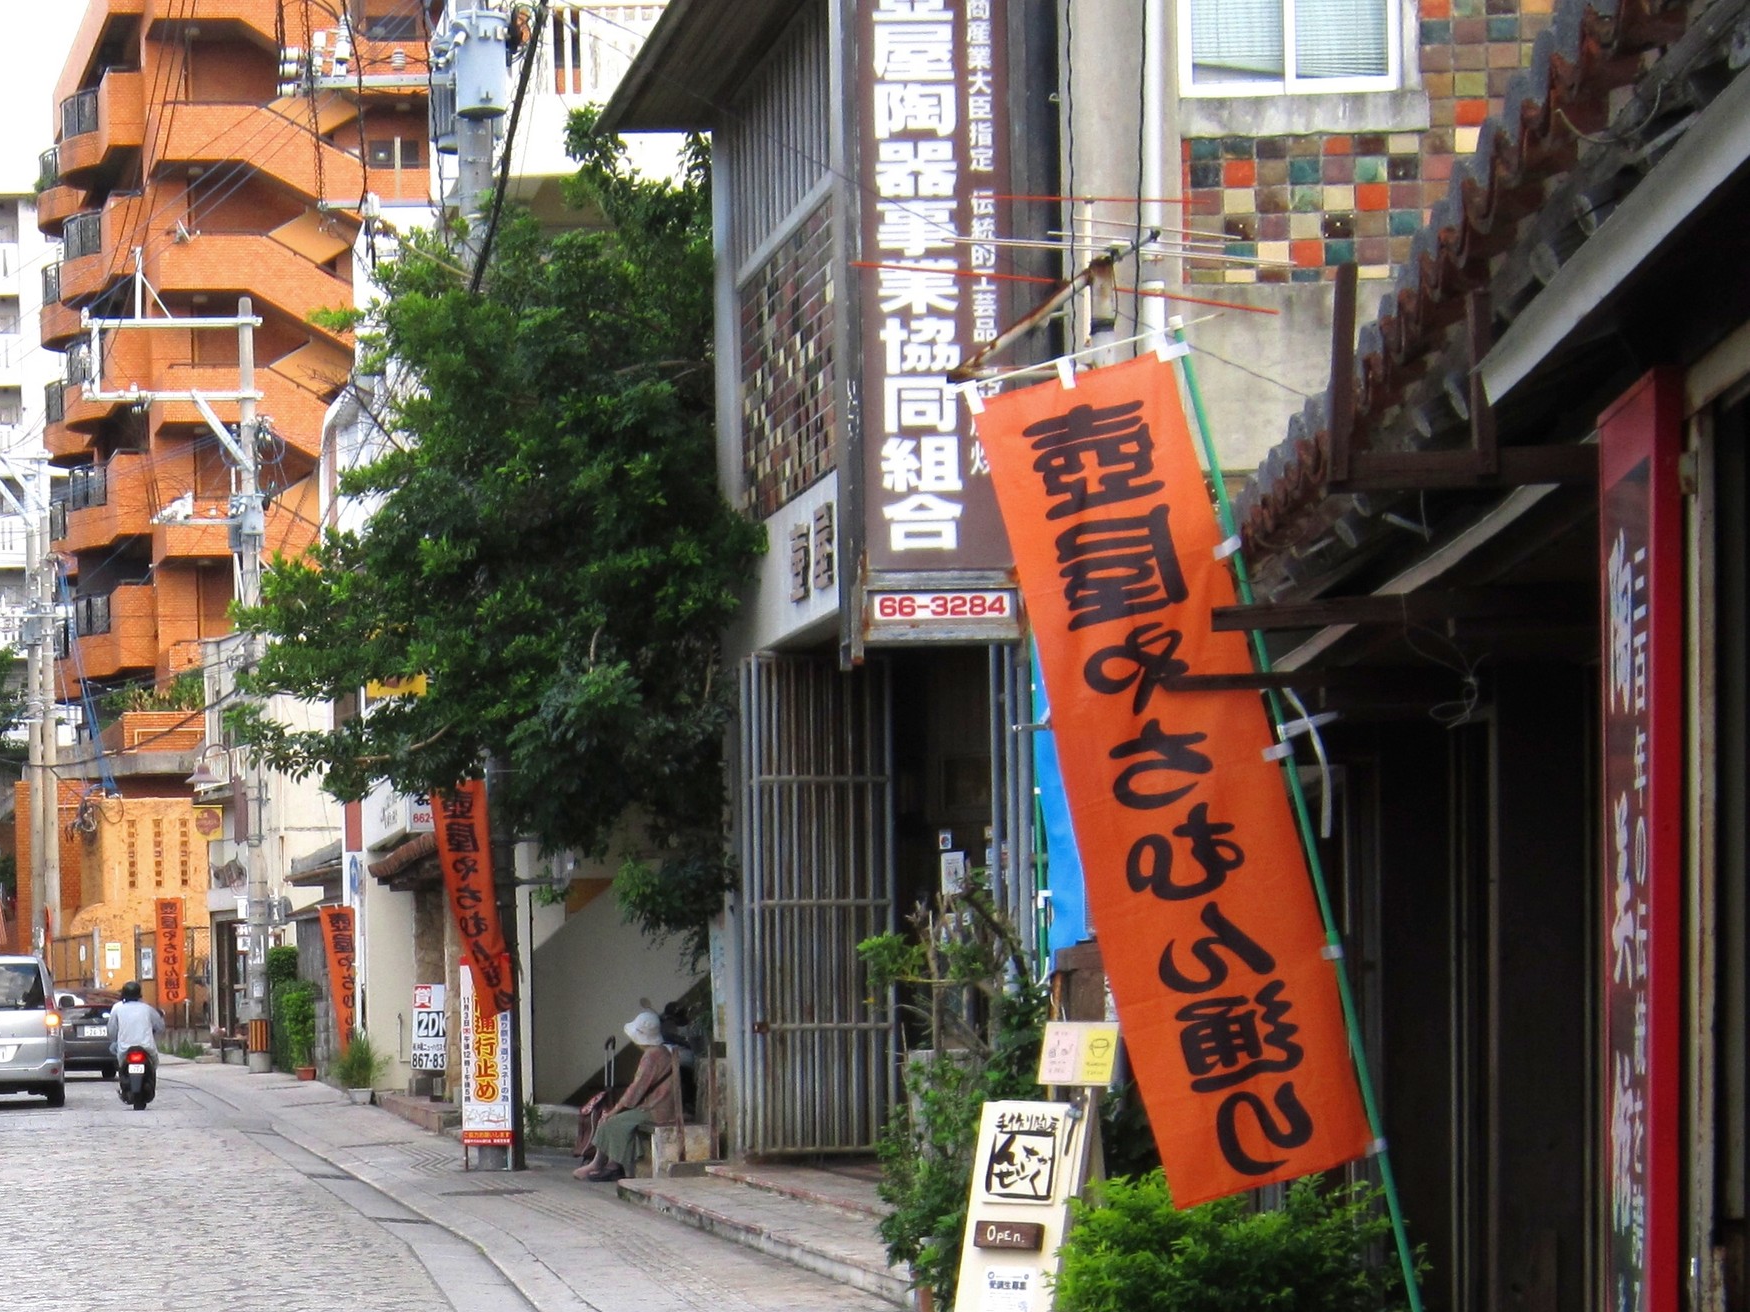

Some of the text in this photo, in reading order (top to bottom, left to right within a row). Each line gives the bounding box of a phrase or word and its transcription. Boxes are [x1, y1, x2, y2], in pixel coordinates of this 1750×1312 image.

[879, 594, 1008, 619] 66-3284
[474, 1010, 500, 1102] 通行止め
